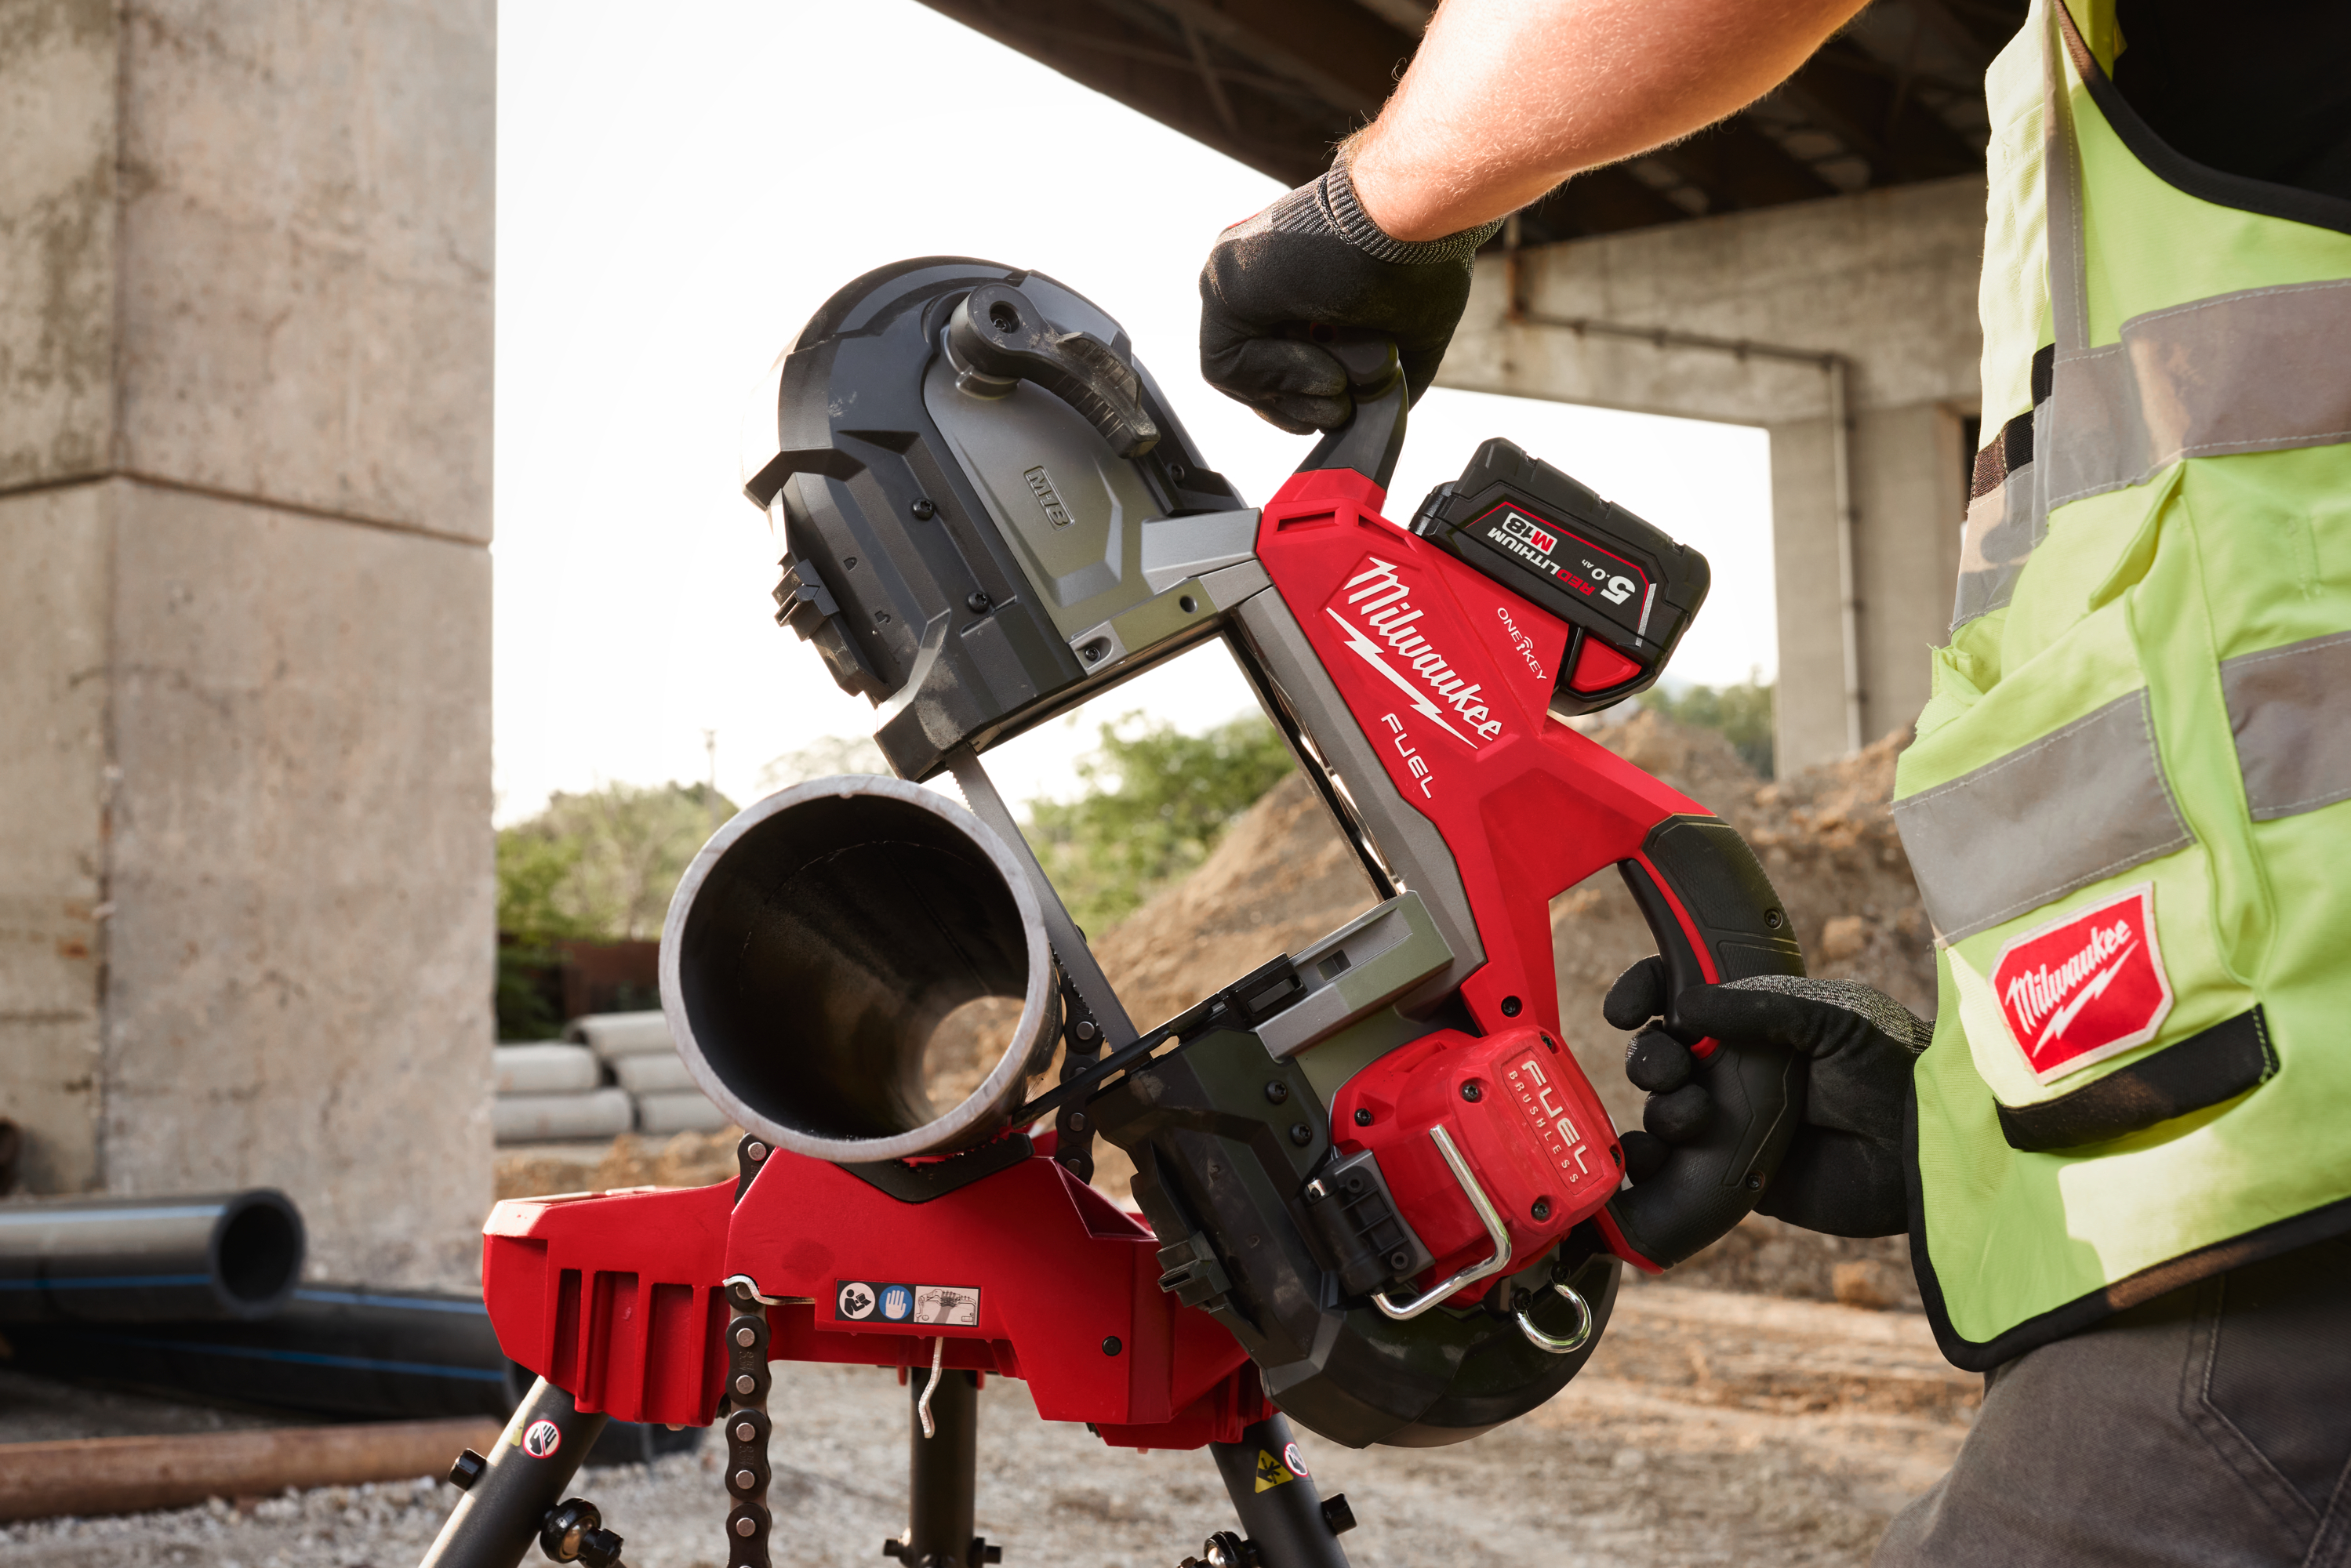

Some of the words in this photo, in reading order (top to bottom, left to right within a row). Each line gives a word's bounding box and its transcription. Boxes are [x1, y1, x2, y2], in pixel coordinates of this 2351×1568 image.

[1027, 470, 1069, 526] M18
[1505, 515, 1555, 553] M18
[1487, 527, 1596, 597] REDLITHIUM
[1581, 559, 1594, 568] Ah
[1591, 568, 1636, 605] 5.0
[1343, 557, 1503, 742] Milwaukee
[1380, 713, 1433, 799] FUEL
[2004, 919, 2132, 1036] Milwaukee
[1509, 1070, 1579, 1183] BRUSHLESS
[1521, 1060, 1589, 1175] FUEL
